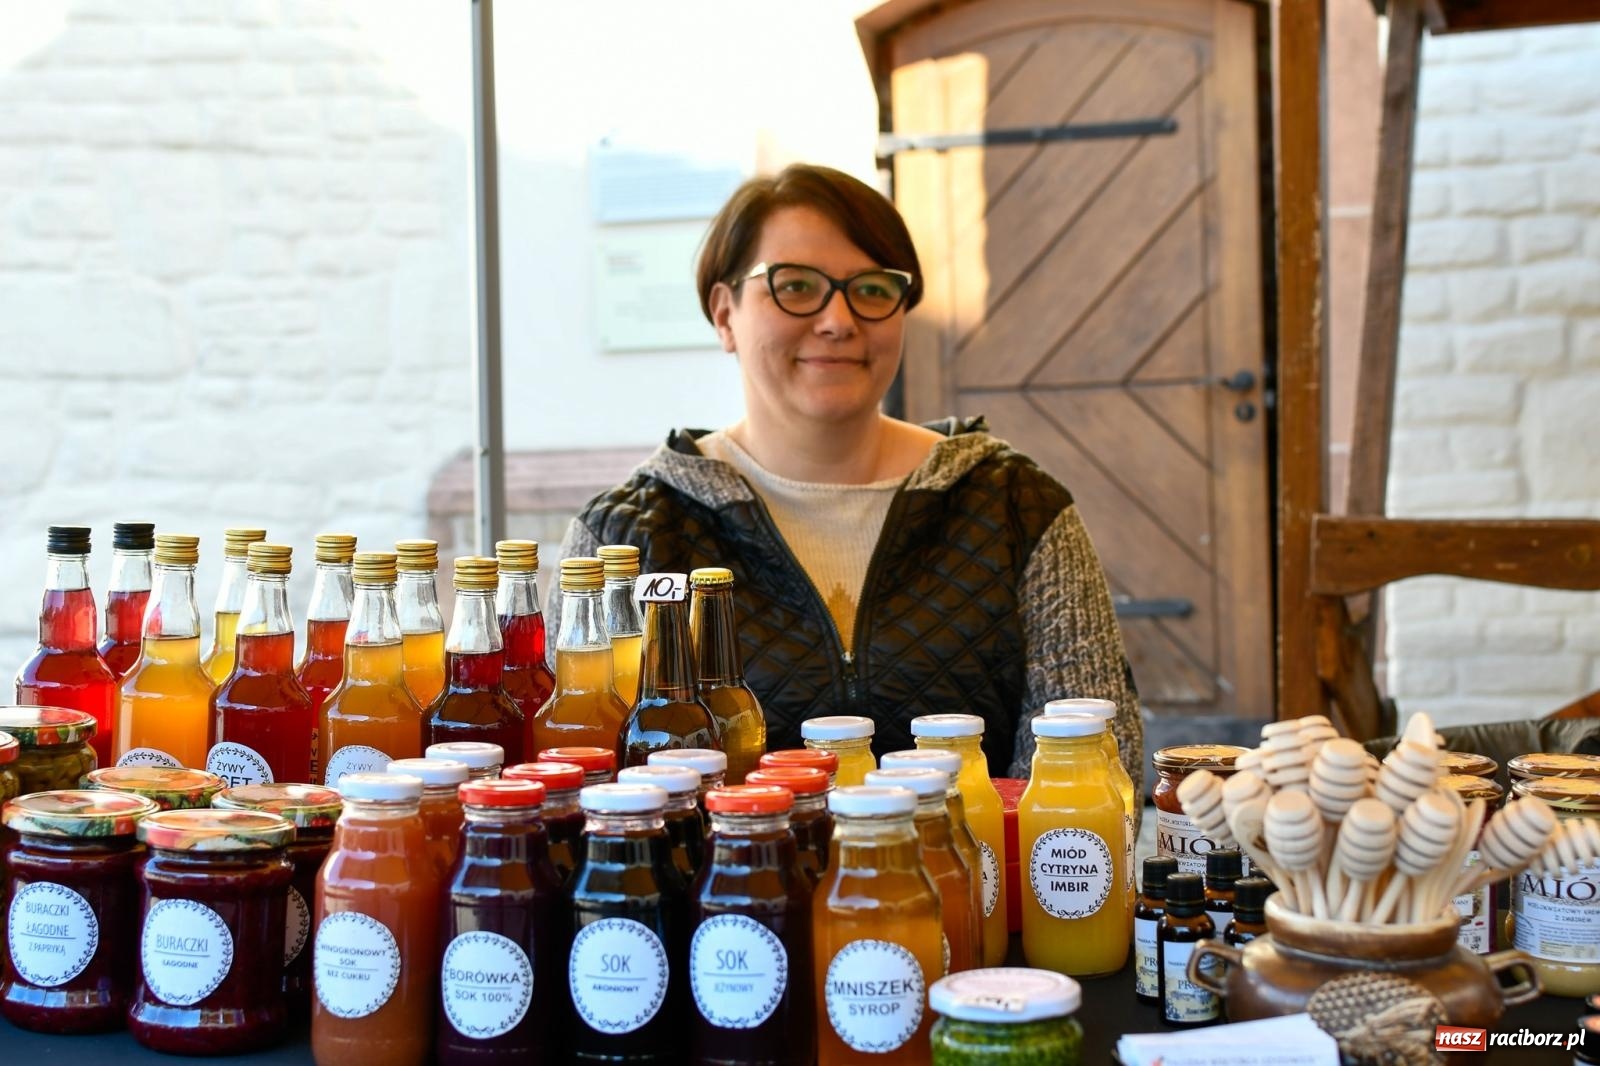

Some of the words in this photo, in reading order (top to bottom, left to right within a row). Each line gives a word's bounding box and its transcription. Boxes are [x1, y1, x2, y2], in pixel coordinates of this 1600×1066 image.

[1050, 846, 1087, 860] MIÓD
[1040, 863, 1099, 876] CYTRYNA
[1050, 881, 1089, 892] IMBIR
[1521, 873, 1600, 901] MIÓ
[25, 901, 70, 917] BURACZKI
[26, 922, 70, 937] ŁAGODNE
[156, 934, 209, 952] BURACZKI
[340, 958, 356, 967] SOK
[601, 953, 631, 973] SOK
[715, 949, 749, 971] SOK
[449, 967, 520, 984] BORÓWKA
[833, 978, 915, 997] MNISZEK
[455, 989, 477, 1001] SOK
[481, 991, 513, 1003] 100%
[848, 1002, 901, 1017] SYROP
